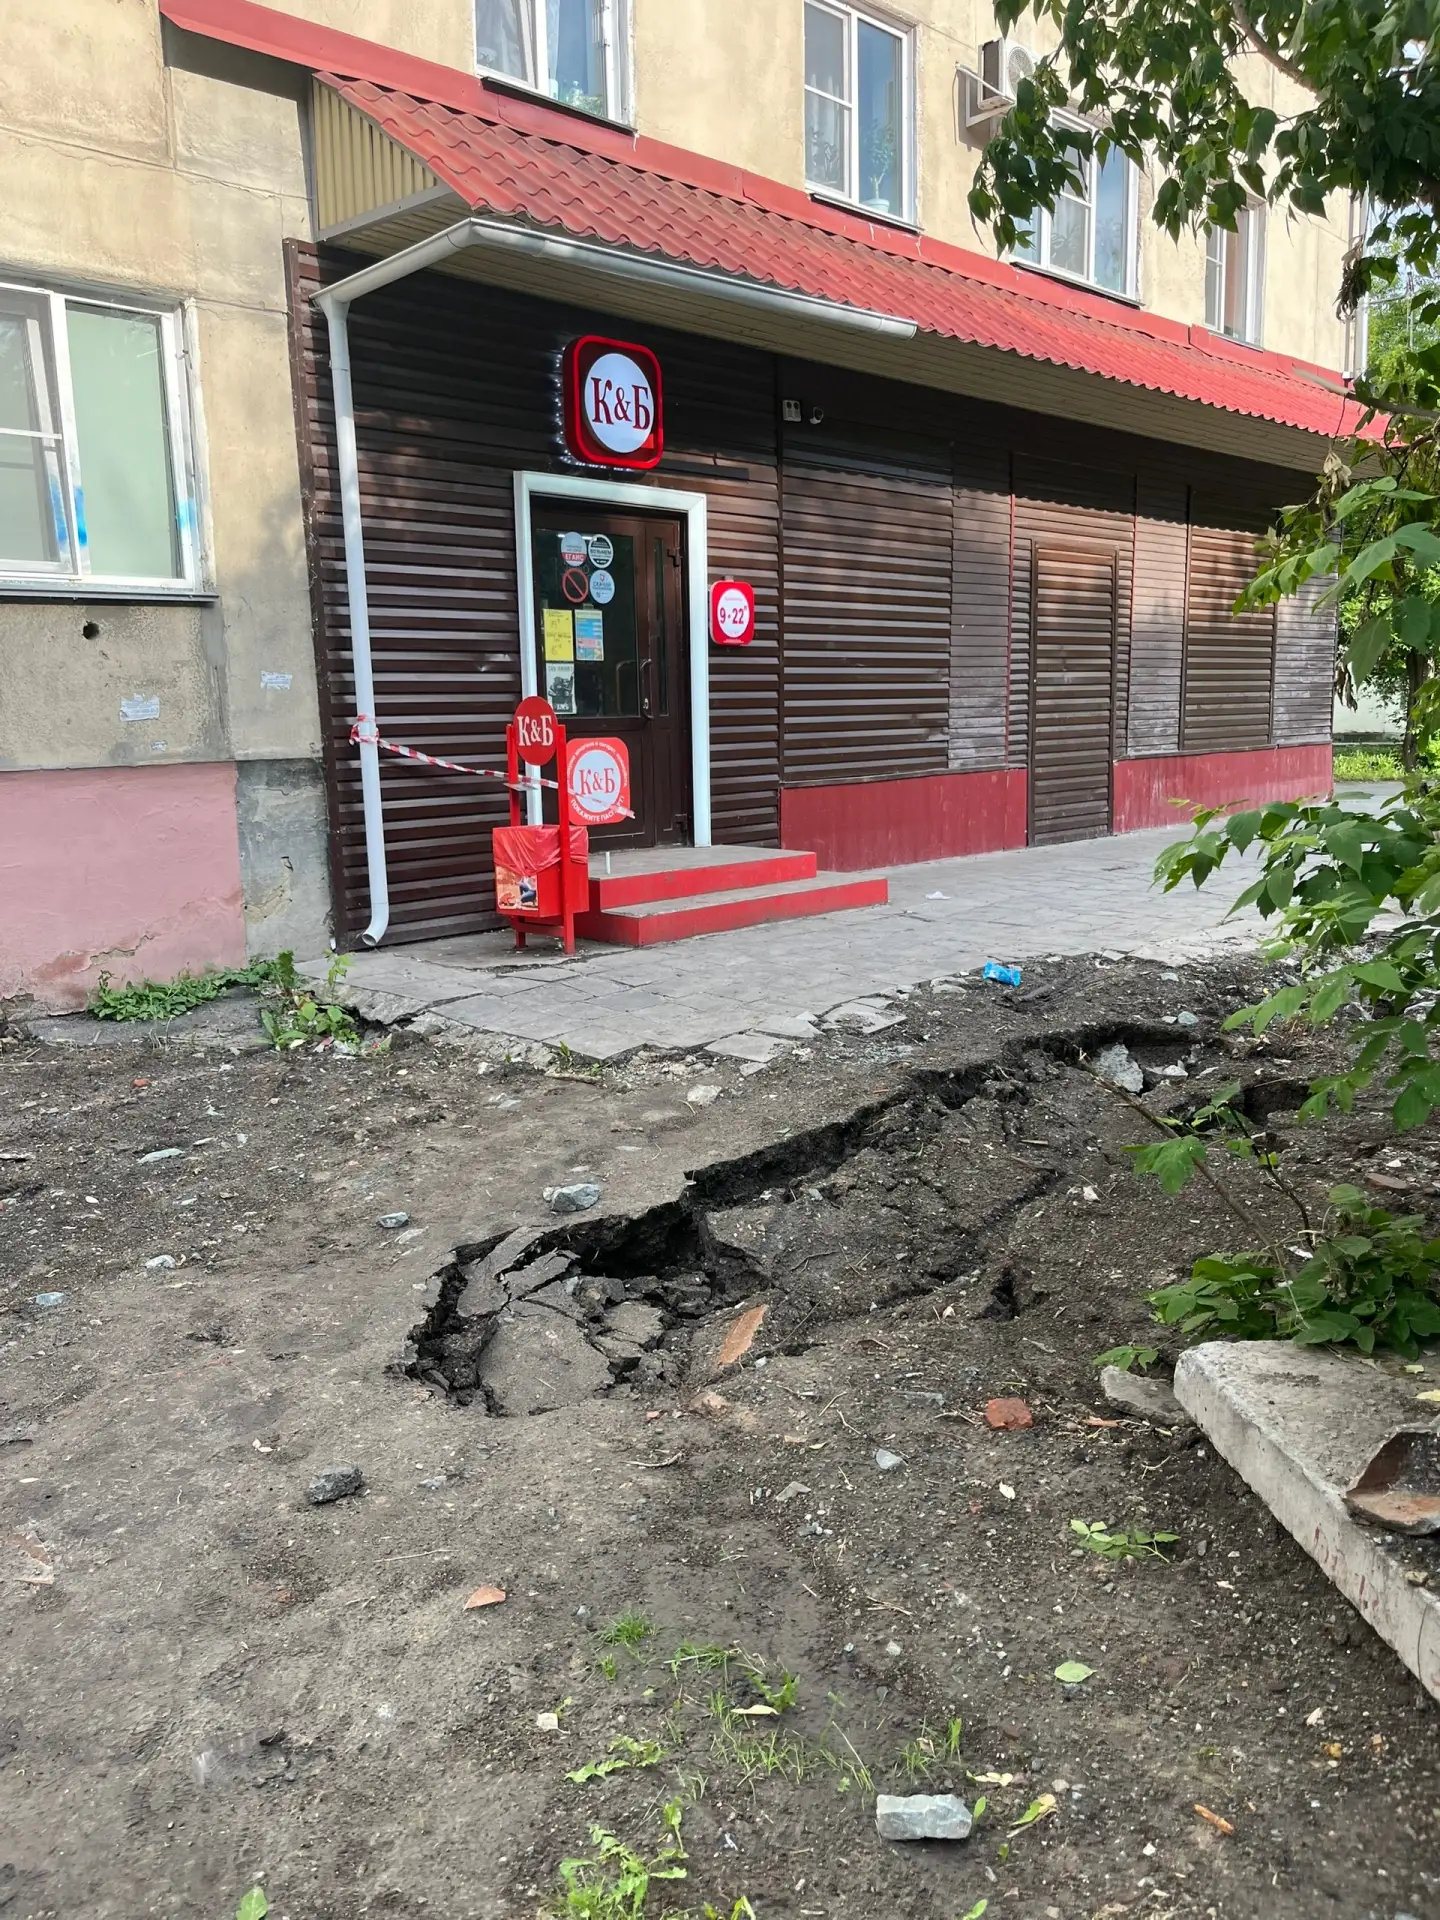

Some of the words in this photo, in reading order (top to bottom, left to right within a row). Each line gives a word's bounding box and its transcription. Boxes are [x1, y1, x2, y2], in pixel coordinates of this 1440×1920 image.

[590, 376, 651, 430] К&Б
[517, 715, 554, 746] К&Б
[578, 767, 616, 796] К&Б
[570, 798, 601, 822] ПОКАЖИТЕ
